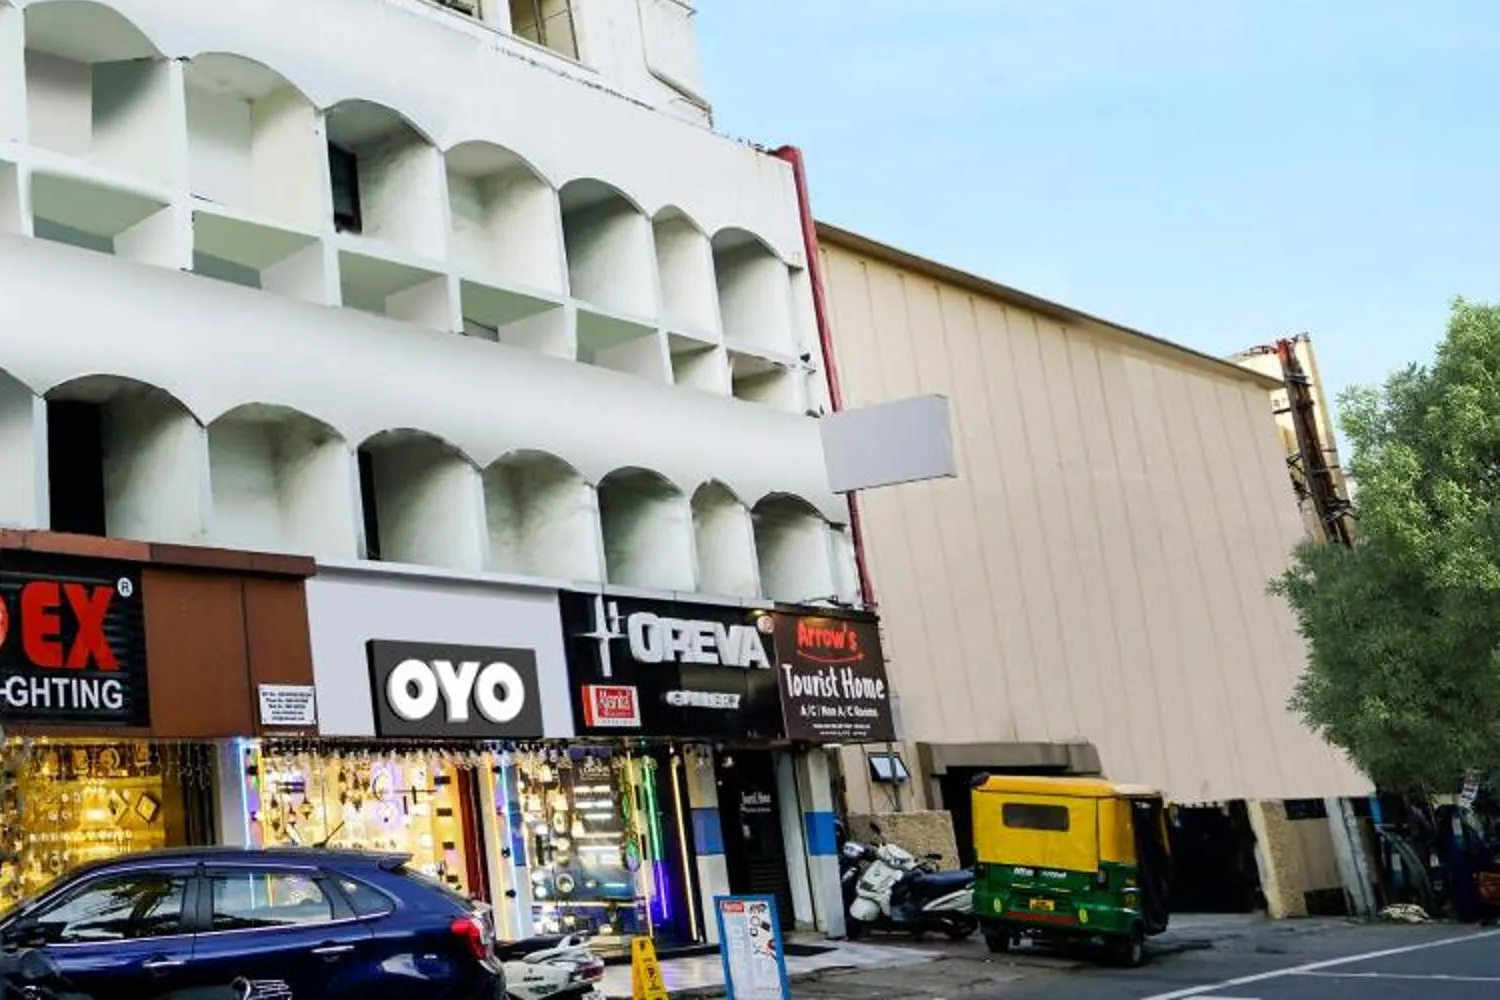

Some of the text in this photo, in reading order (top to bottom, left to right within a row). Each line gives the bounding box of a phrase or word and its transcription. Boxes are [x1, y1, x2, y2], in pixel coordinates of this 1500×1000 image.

[628, 611, 771, 669] OREVA
[797, 620, 858, 651] Arrow's
[386, 658, 525, 723] OYO
[782, 663, 885, 699] Tourist Home
